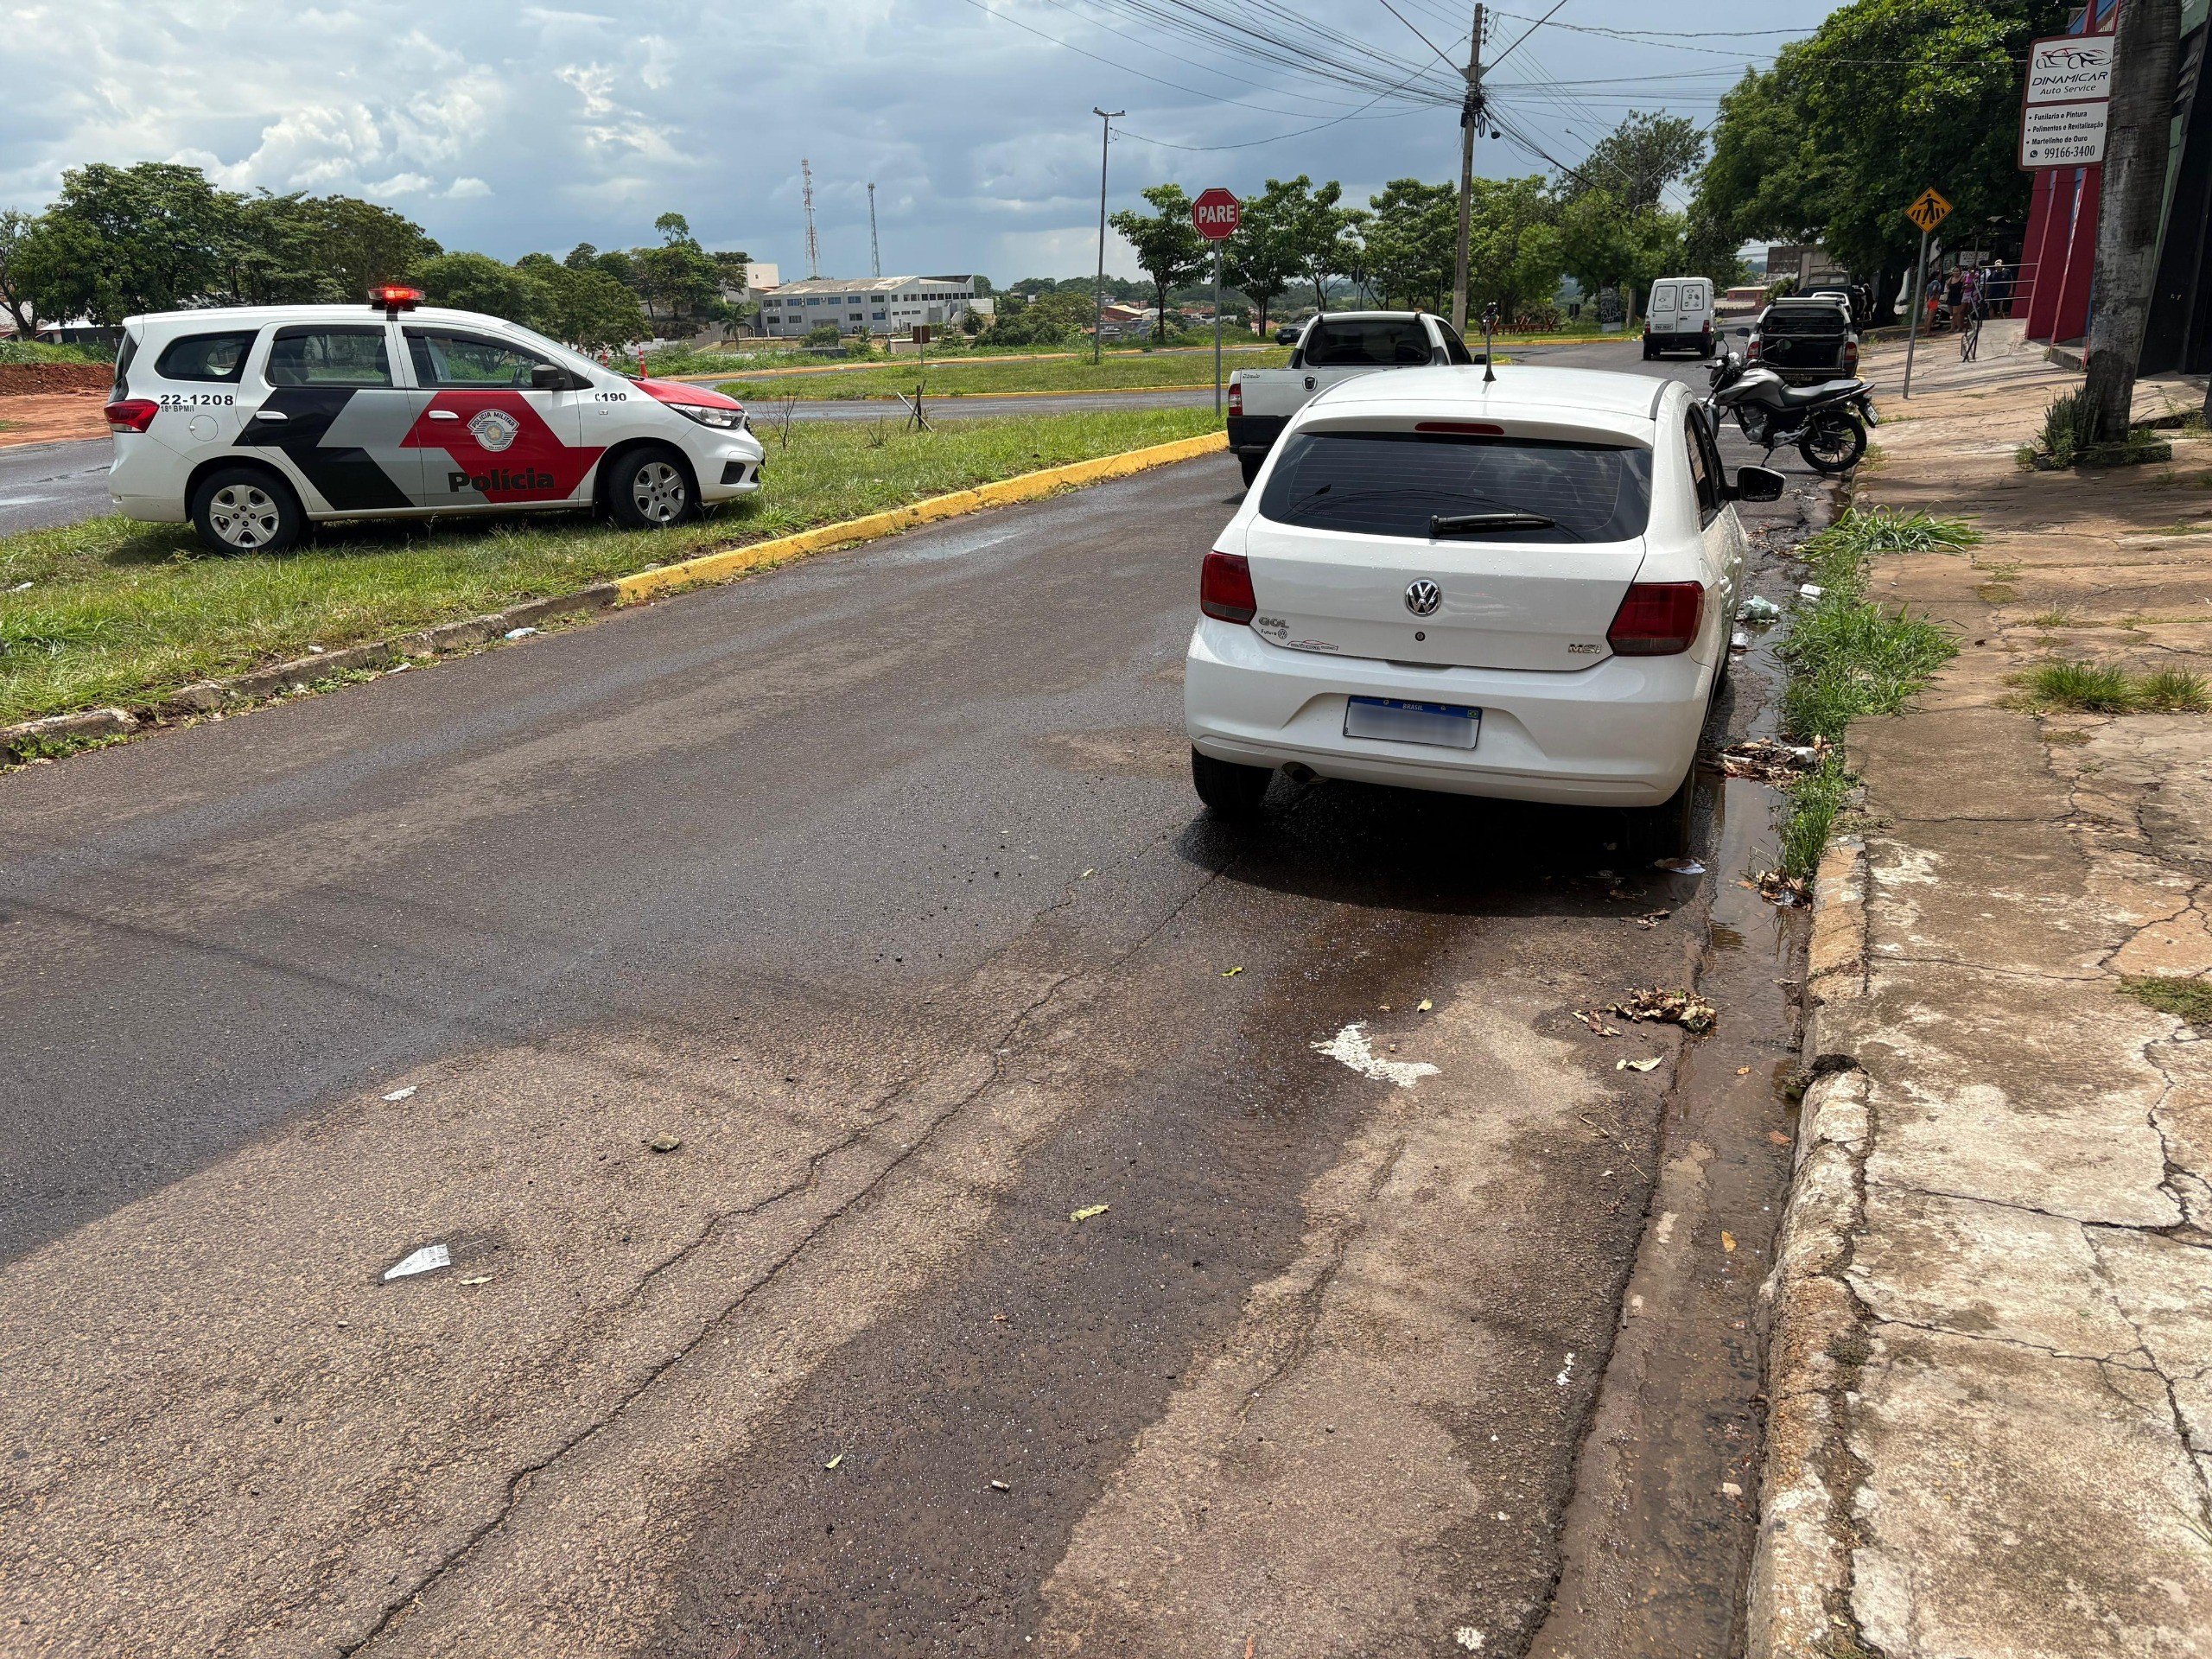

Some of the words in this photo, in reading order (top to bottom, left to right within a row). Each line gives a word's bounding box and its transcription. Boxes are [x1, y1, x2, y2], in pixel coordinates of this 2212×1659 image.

[2032, 71, 2108, 86] DINAMICAR
[2063, 84, 2097, 93] Service
[2034, 112, 2060, 121] Funilaria
[2032, 124, 2063, 133] Polimentos
[2068, 121, 2104, 130] Revitalização
[2031, 137, 2063, 145] Martelinho
[2044, 145, 2095, 159] 99166-3400
[1198, 204, 1236, 224] PARE
[160, 394, 234, 406] 22-1208
[601, 392, 627, 402] 190
[493, 411, 516, 428] MILITAR
[448, 467, 555, 493] Polícia
[1258, 616, 1289, 628] GOL
[1402, 702, 1425, 712] BRASIL
